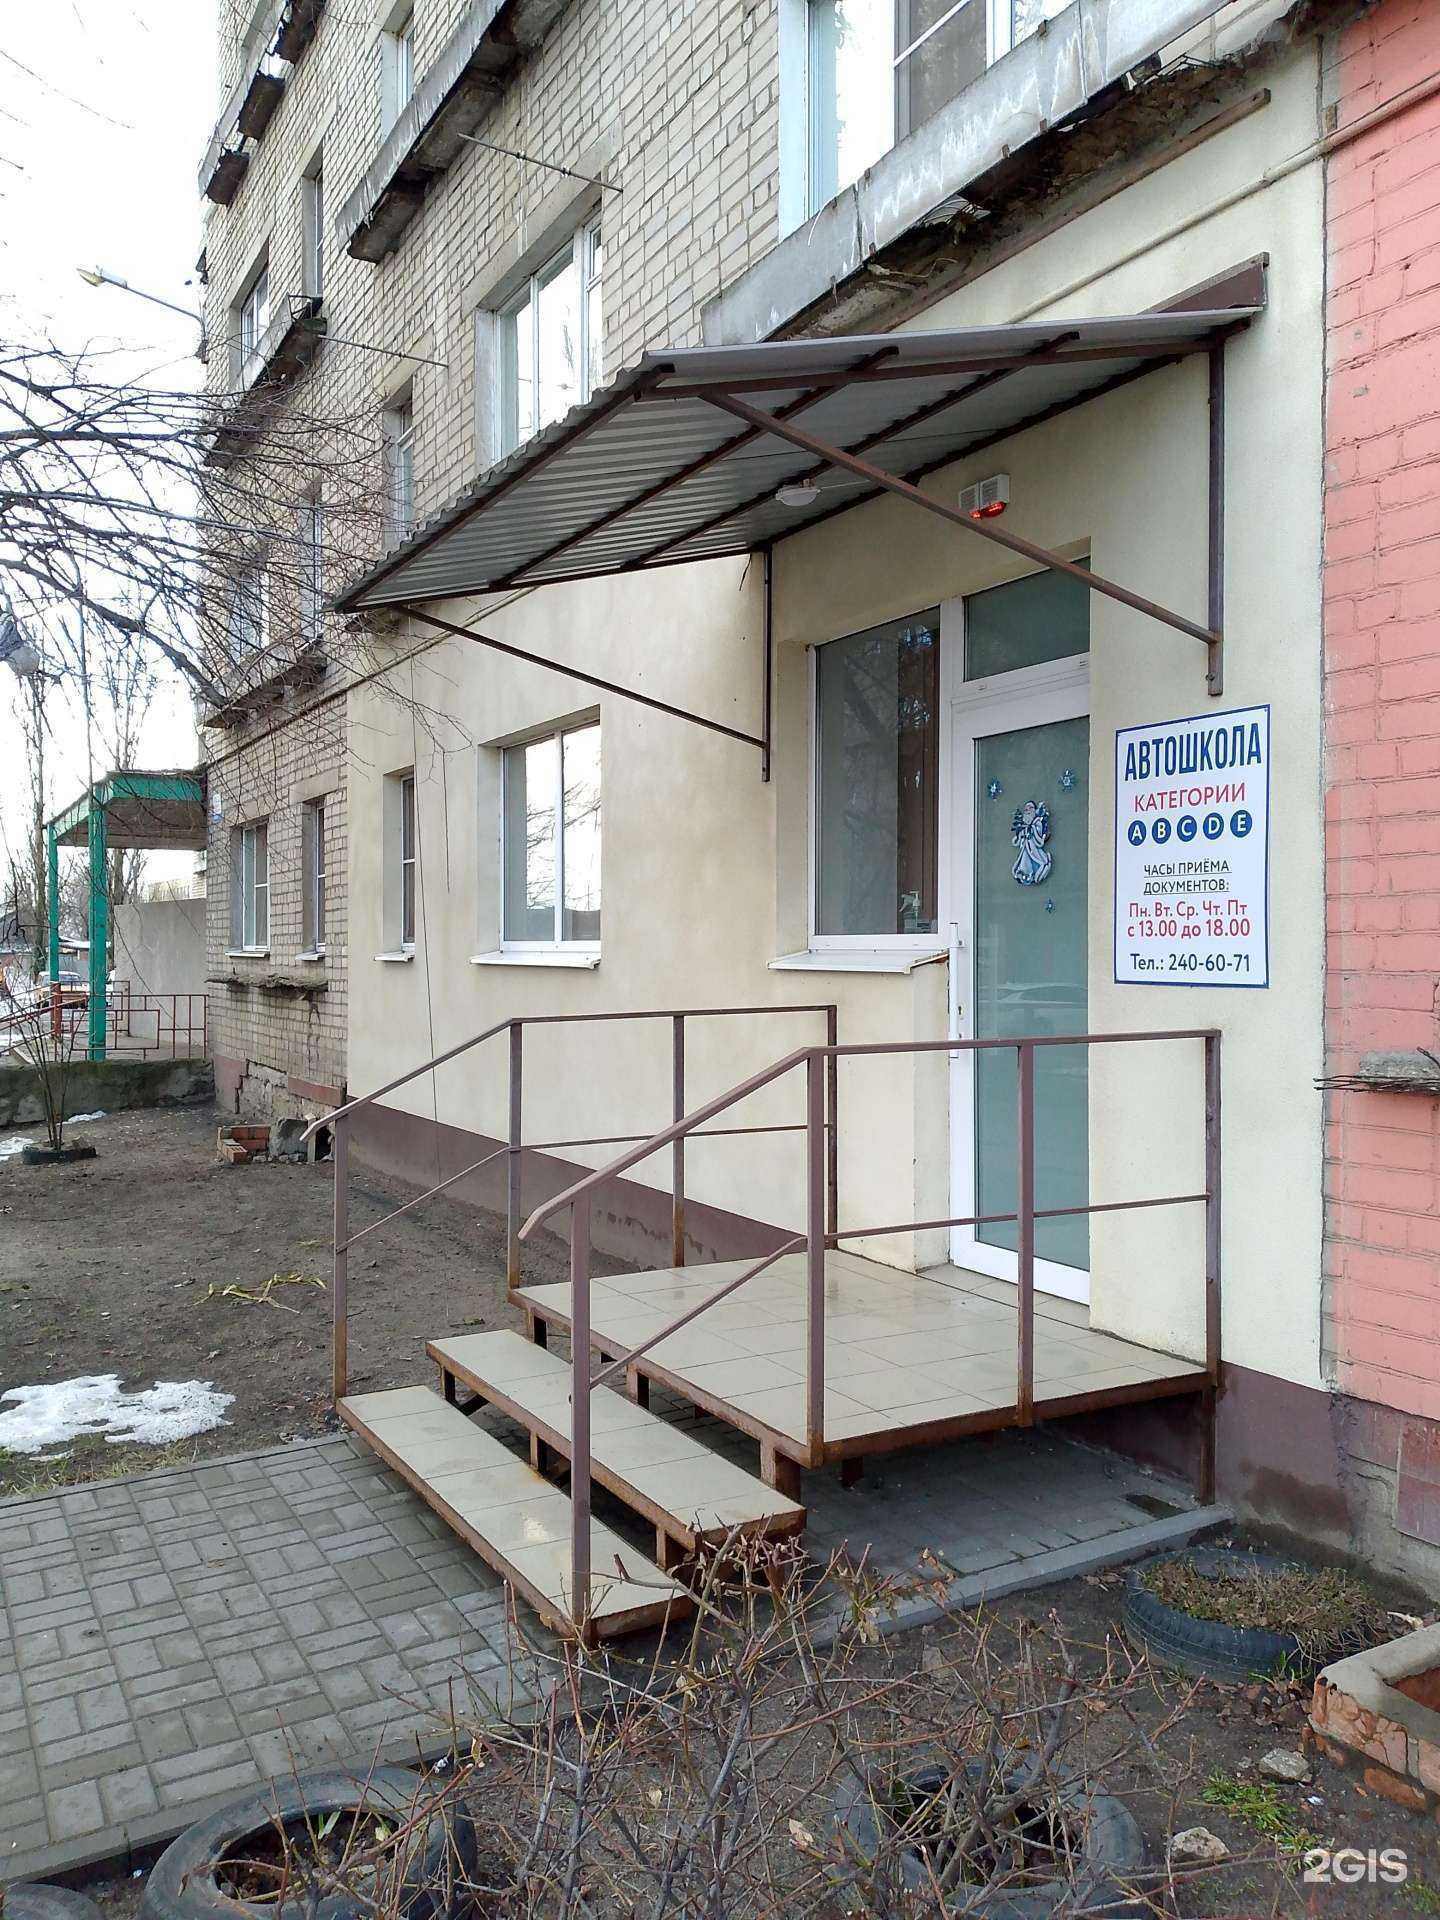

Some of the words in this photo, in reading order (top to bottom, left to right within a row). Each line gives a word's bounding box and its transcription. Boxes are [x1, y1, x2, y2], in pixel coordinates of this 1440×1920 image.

[1125, 723, 1262, 781] АВТОШКОЛА
[1135, 782, 1246, 812] КАТЕГОРИИ
[1181, 819, 1193, 836] C
[1208, 817, 1220, 834] D
[1237, 814, 1247, 832] E
[1143, 863, 1176, 876] ЧАСЫ
[1178, 858, 1230, 874] ПРИЁМА
[1143, 879, 1230, 895] ДОКУМЕНТОВ:
[1129, 902, 1151, 918] Пн.
[1155, 902, 1173, 917] Вт.
[1176, 901, 1199, 920] Ср.
[1203, 900, 1223, 916] Чт.
[1228, 899, 1247, 916] Пт
[1127, 925, 1135, 937] с
[1139, 919, 1177, 937] 13.00
[1181, 924, 1201, 939] до
[1206, 918, 1250, 937] 18.00
[1130, 953, 1164, 970] Тел.:
[1168, 953, 1250, 972] 240-60-71
